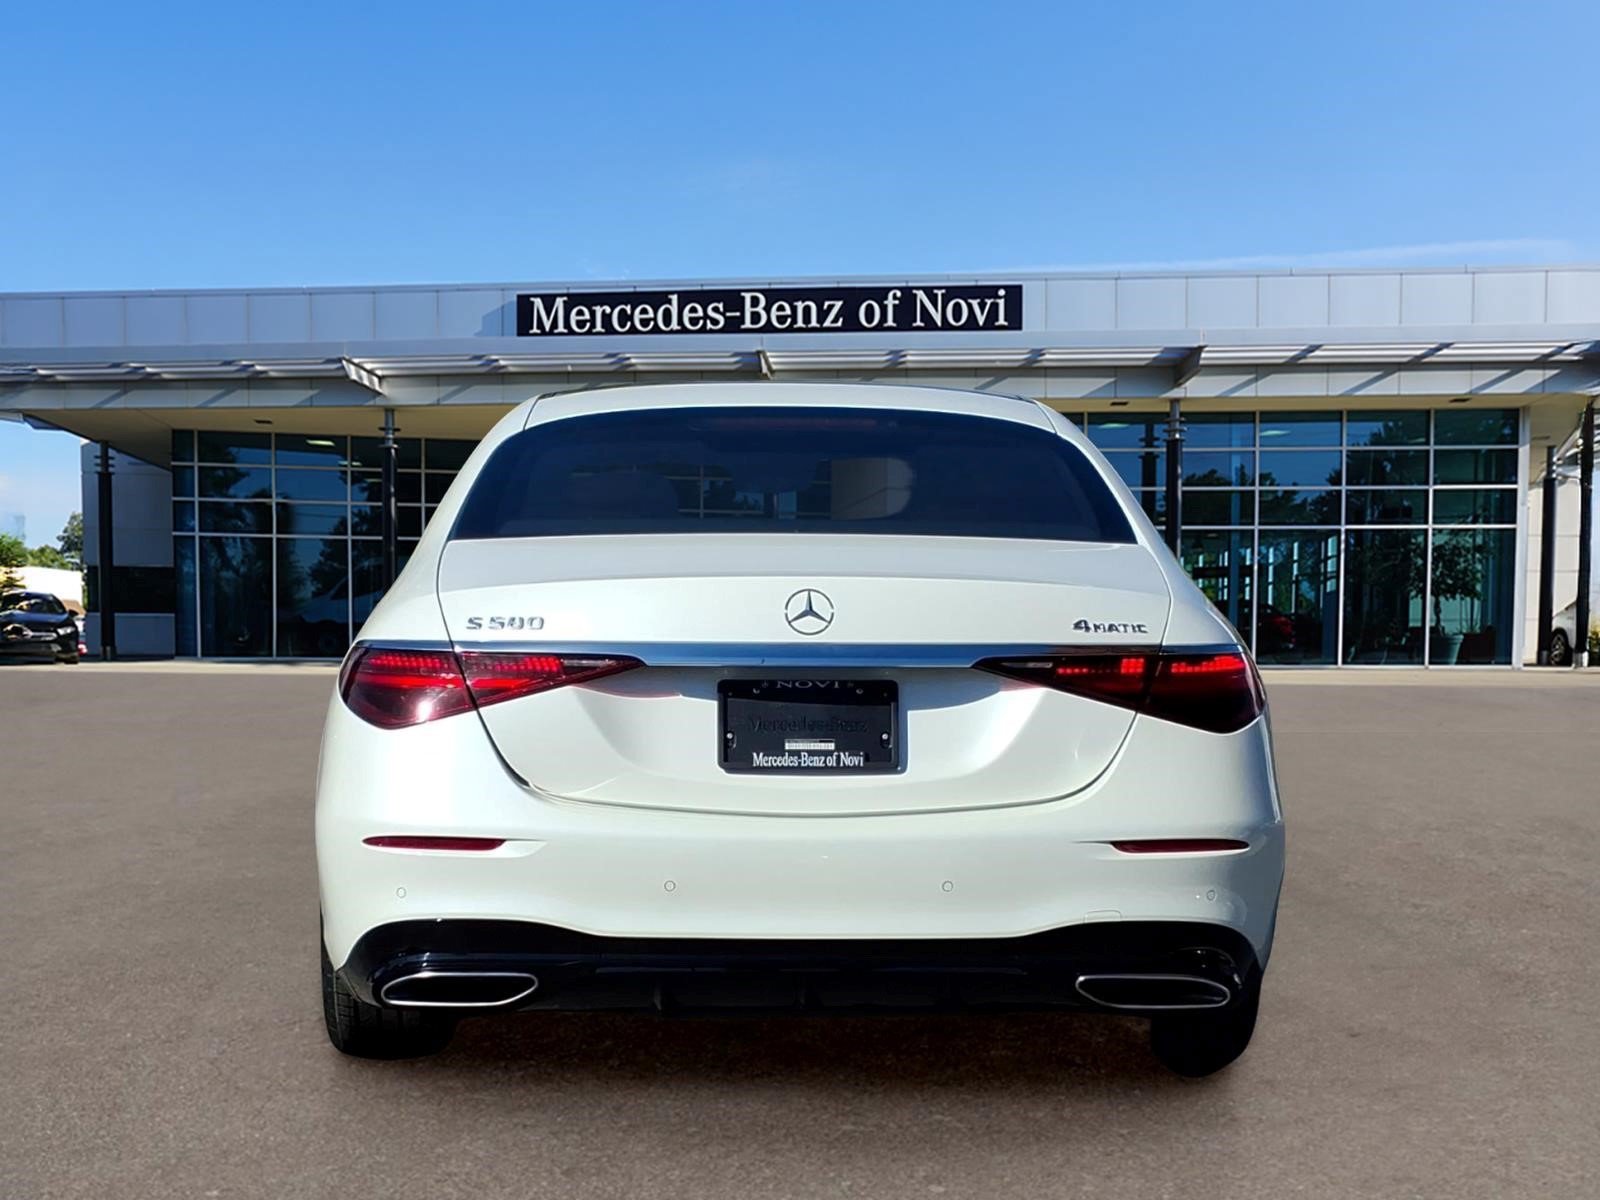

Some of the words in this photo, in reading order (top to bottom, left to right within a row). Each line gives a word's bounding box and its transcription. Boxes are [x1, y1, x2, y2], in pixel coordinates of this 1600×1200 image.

[528, 292, 843, 334] Mercedes-Benz
[858, 290, 901, 328] of
[912, 288, 1009, 327] Novi
[1072, 619, 1148, 634] 4MATIC
[776, 680, 840, 688] NOVI
[752, 752, 825, 767] Mercedes-Benz
[826, 752, 839, 767] of
[840, 752, 864, 767] Novi
